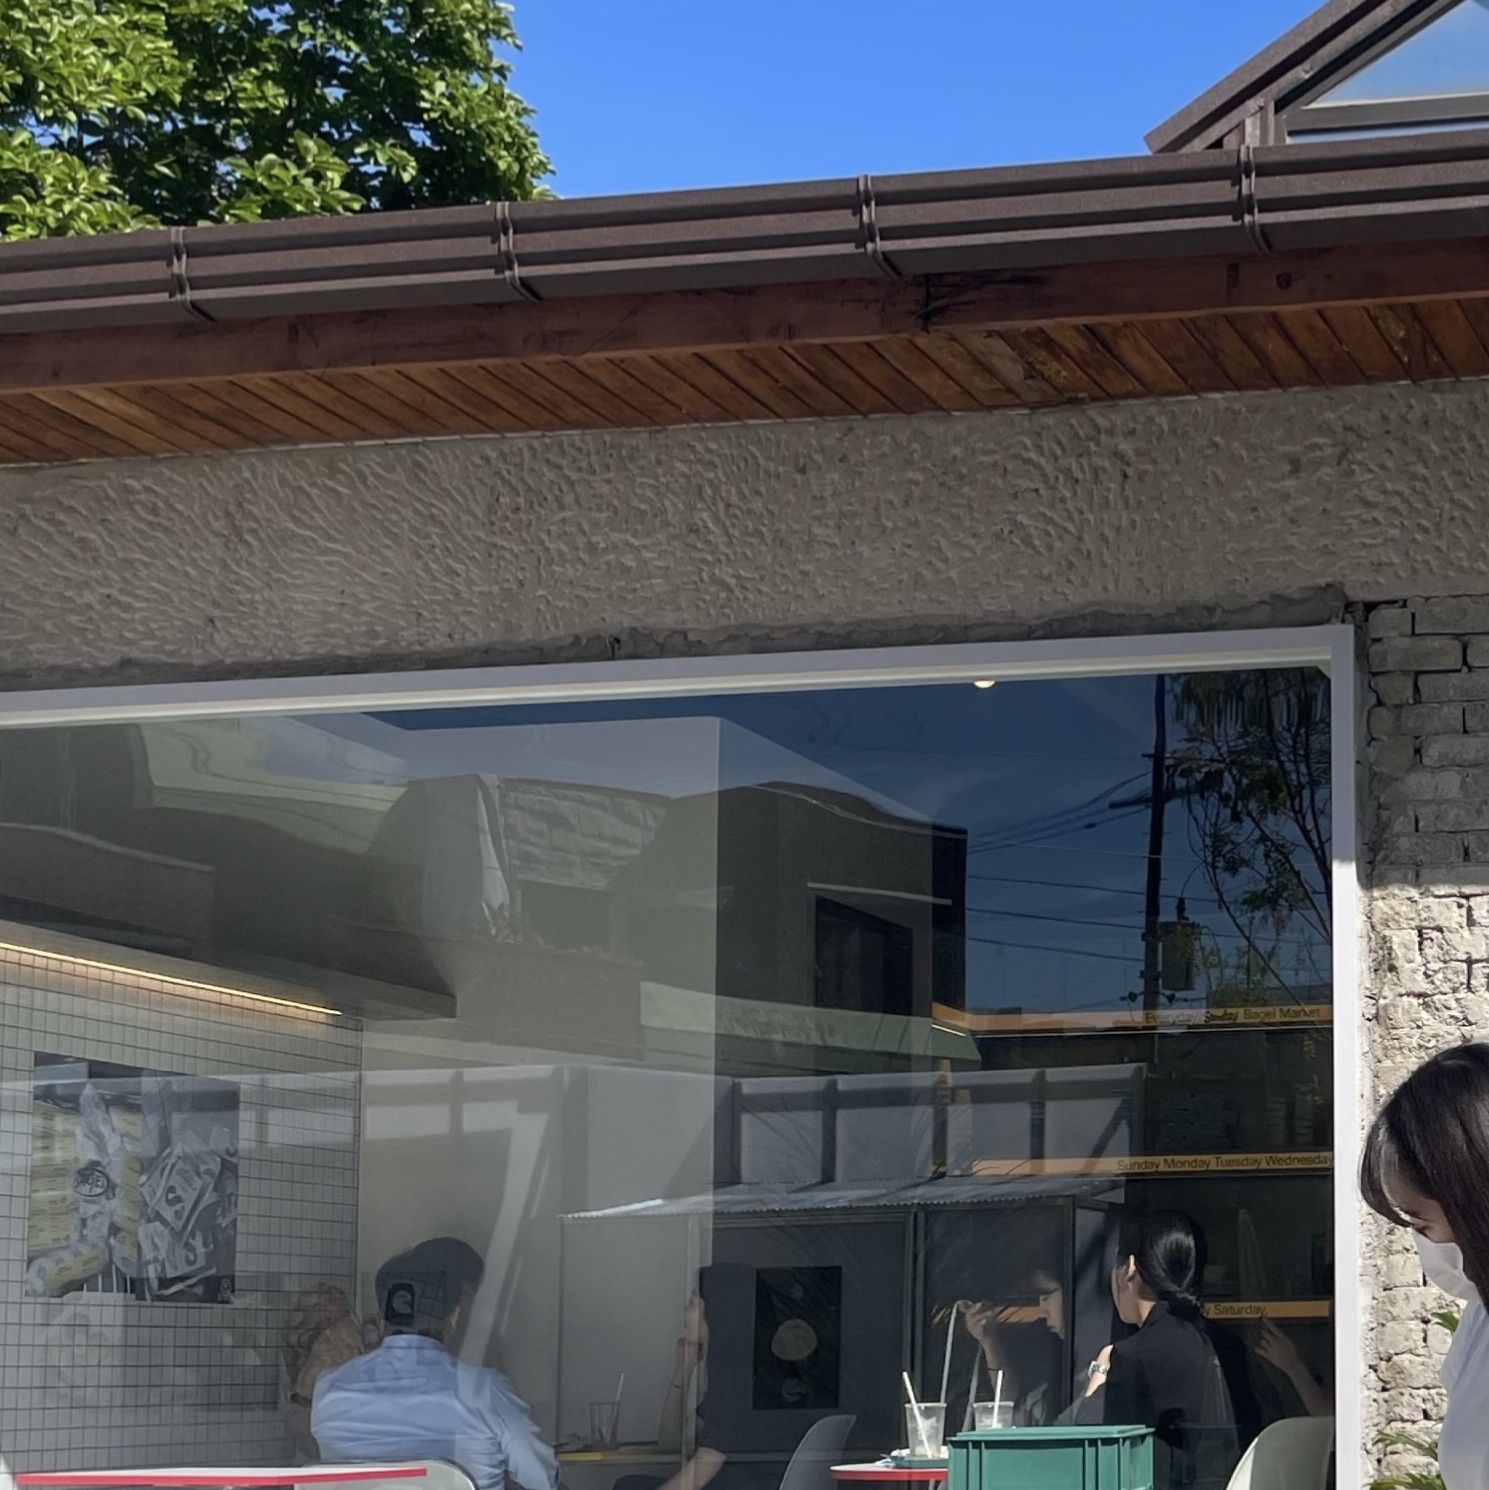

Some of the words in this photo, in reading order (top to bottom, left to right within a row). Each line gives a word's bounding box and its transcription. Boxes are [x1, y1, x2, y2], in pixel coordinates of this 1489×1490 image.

[1243, 1008, 1277, 1021] Bagel
[1279, 1006, 1321, 1019] Market
[1117, 1158, 1160, 1172] Sunday
[1163, 1157, 1210, 1170] Monday
[1214, 1156, 1262, 1169] Tuesday
[1264, 1154, 1333, 1167] Wednesday
